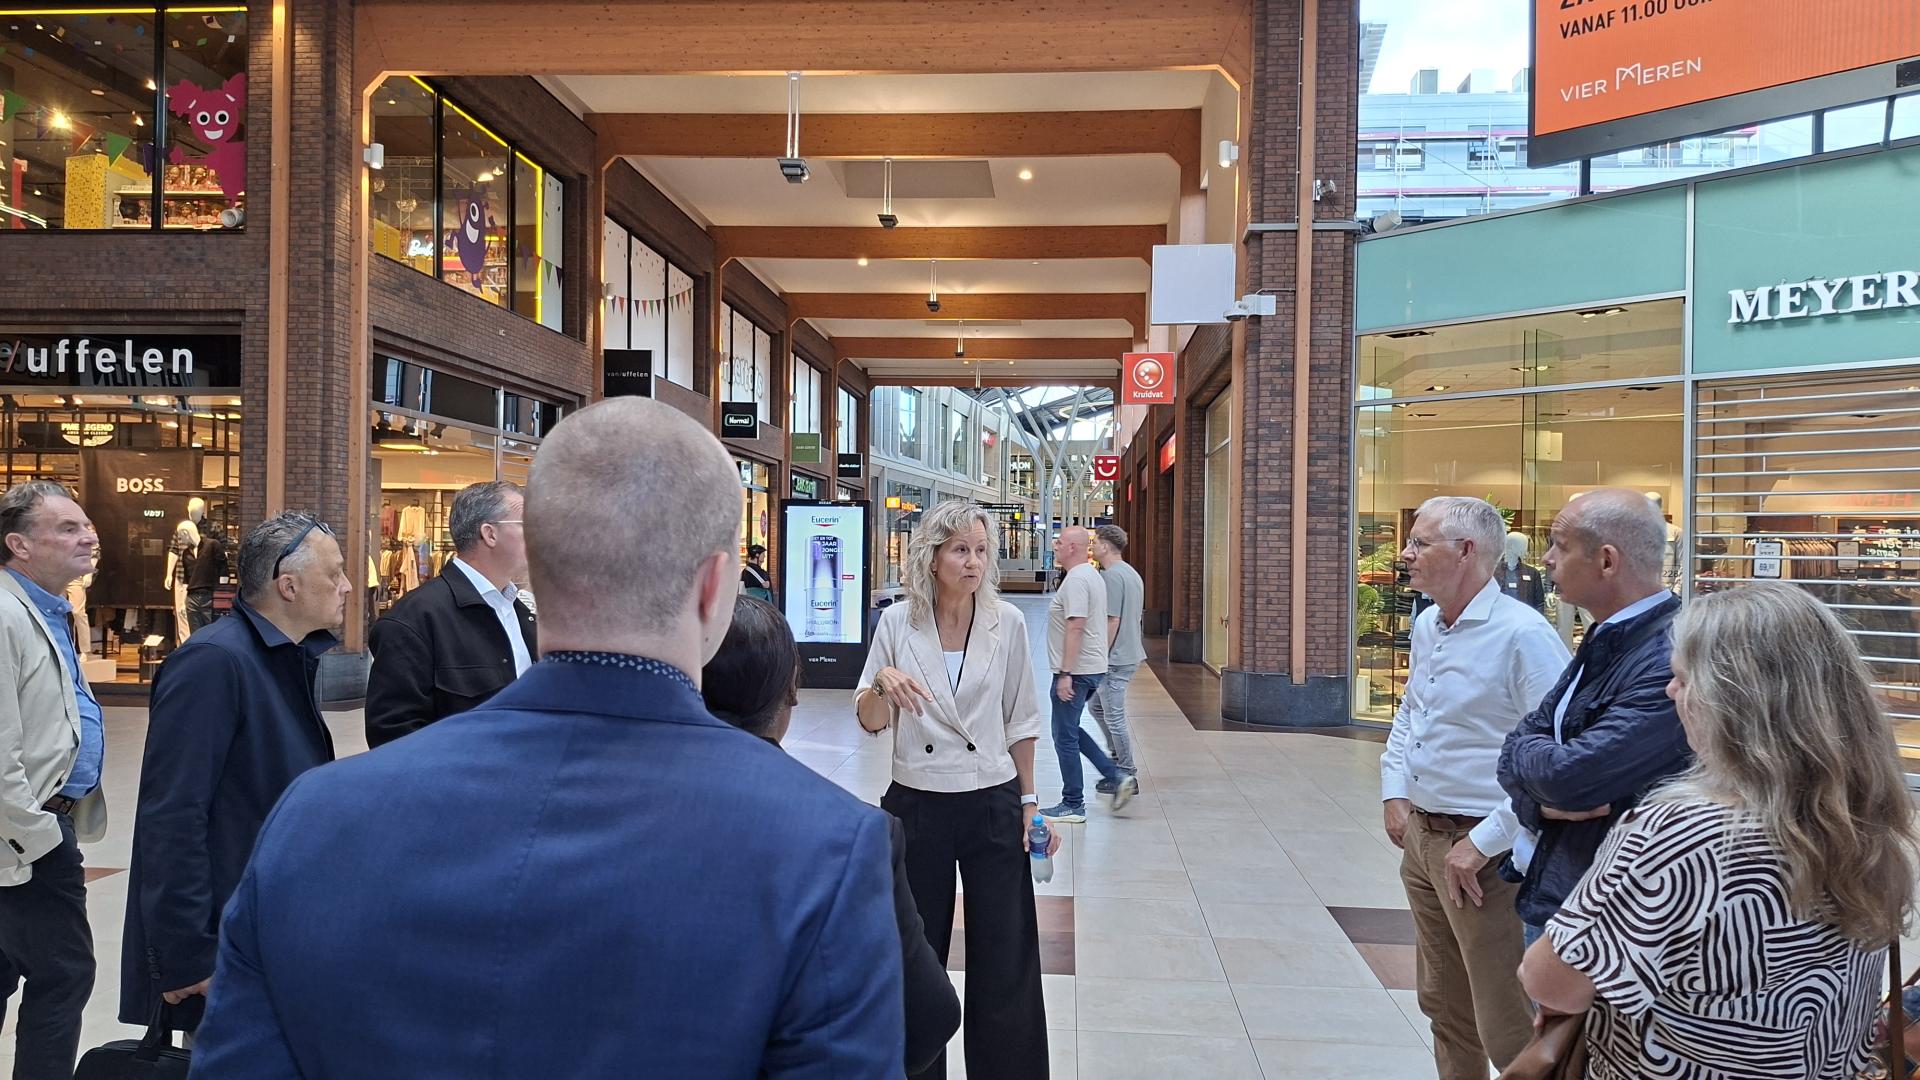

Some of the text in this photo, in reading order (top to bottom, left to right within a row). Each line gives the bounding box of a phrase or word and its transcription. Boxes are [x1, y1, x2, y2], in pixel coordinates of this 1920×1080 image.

[1560, 0, 1667, 39] VANAF 11.00
[1560, 56, 1701, 102] VIER MEREN
[1727, 270, 1920, 324] MEYER
[1132, 390, 1164, 398] Kruidvat
[729, 416, 750, 425] Normal
[116, 477, 165, 493] BOSS
[811, 515, 839, 523] Eucerin
[810, 599, 838, 608] Eucerin
